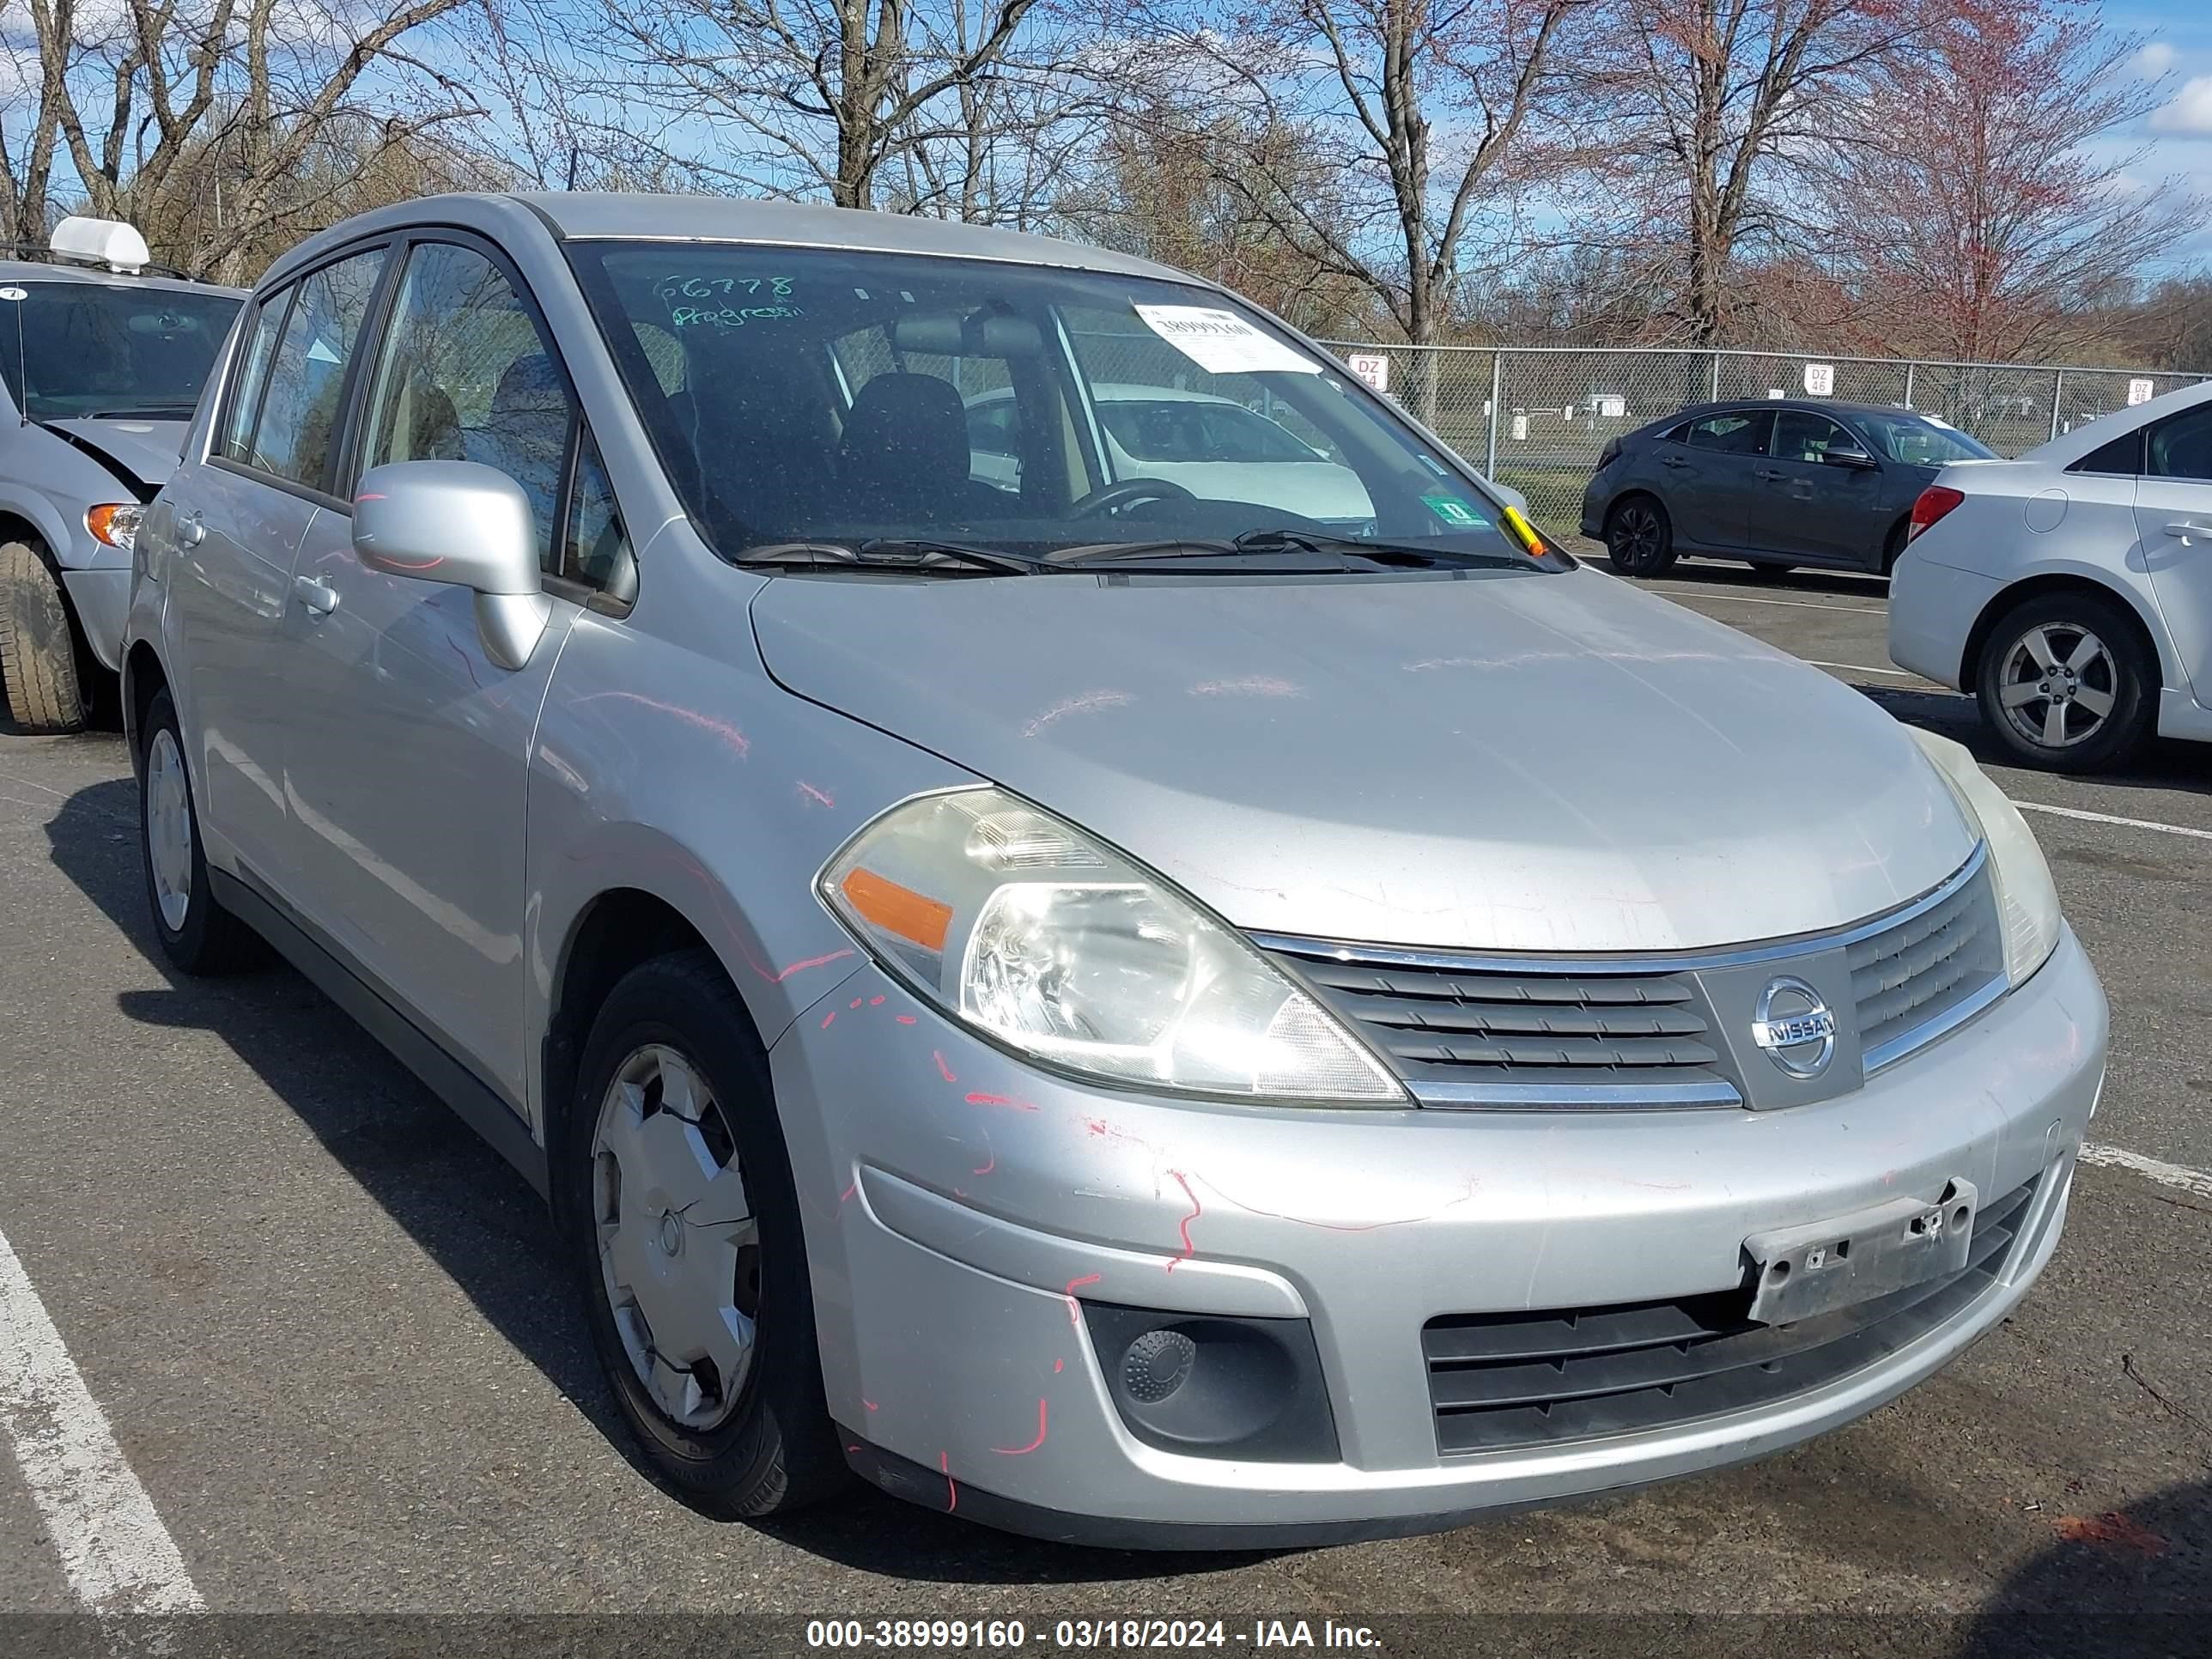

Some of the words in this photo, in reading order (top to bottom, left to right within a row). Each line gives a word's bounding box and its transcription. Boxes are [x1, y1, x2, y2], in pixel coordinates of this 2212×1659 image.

[1157, 320, 1252, 336] 38999160
[1358, 361, 1379, 373] DZ
[1812, 369, 1827, 380] DZ
[1812, 381, 1826, 392] 46
[2135, 383, 2148, 392] DZ
[1768, 1017, 1834, 1042] NISSAN
